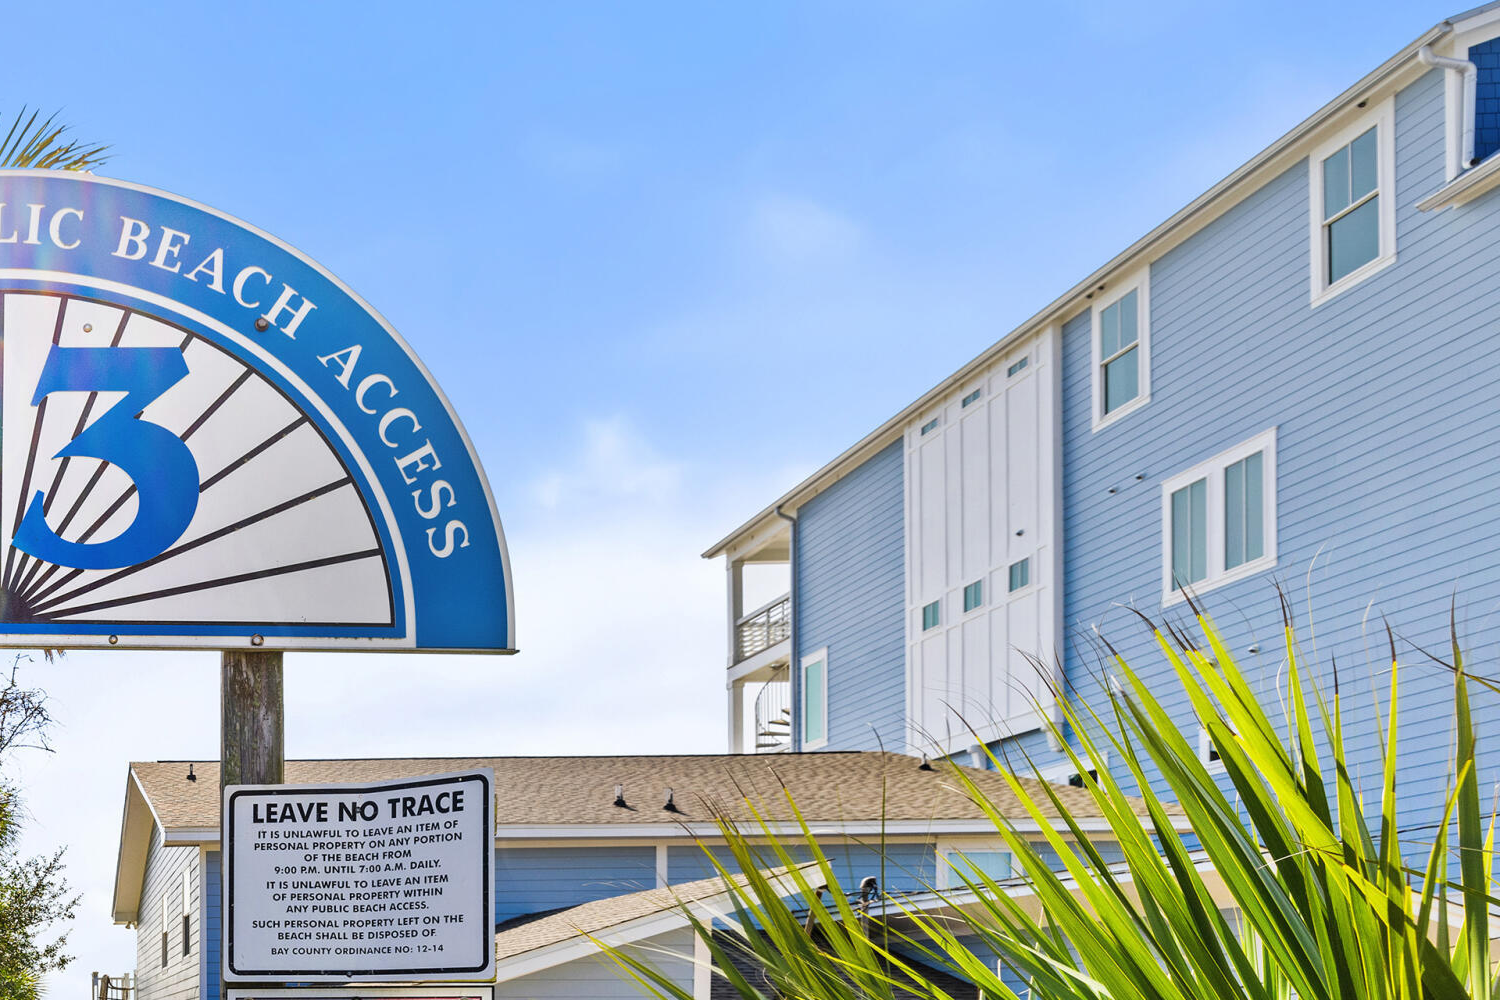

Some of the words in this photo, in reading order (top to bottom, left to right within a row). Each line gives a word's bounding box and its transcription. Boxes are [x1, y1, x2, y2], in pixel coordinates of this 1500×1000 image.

[111, 216, 318, 340] BEACH
[316, 344, 471, 559] ACCESS
[252, 802, 328, 823] LEAVE
[338, 800, 378, 822] NO
[387, 790, 464, 818] TRACE
[258, 830, 267, 839] IT
[270, 830, 279, 838] IS
[283, 829, 342, 838] UNLAWFUL
[345, 829, 359, 837] TO
[362, 826, 393, 837] LEAVE
[396, 824, 412, 834] AN
[416, 822, 440, 832] ITEM
[443, 819, 458, 829] OF
[254, 842, 309, 850] PERSONAL
[312, 841, 365, 850] PROPERTY
[368, 839, 385, 848] ON
[388, 836, 410, 846] ANY
[413, 831, 462, 844] PORTION
[304, 853, 318, 862] OF
[321, 853, 341, 861] THE
[345, 852, 378, 861] BEACH
[382, 849, 411, 859] FROM
[274, 866, 296, 874] 9:00
[300, 865, 320, 874] P.M.
[324, 865, 355, 874] UNTIL
[358, 864, 381, 872] 7:00
[383, 862, 406, 871] A.M.
[410, 859, 441, 869] DAILY.
[266, 881, 275, 889] IT
[279, 880, 288, 889] IS
[292, 880, 350, 889] UNLAWFUL
[353, 880, 367, 888] TO
[371, 877, 401, 887] LEAVE
[404, 876, 420, 885] AN
[424, 874, 448, 884] ITEM
[272, 893, 286, 901] OF
[290, 892, 345, 901] PERSONAL
[349, 890, 400, 900] PROPERTY
[403, 887, 442, 897] WITHIN
[312, 904, 349, 913] PUBLIC
[352, 903, 386, 912] BEACH
[389, 900, 429, 911] ACCESS.
[252, 920, 280, 928] SUCH
[284, 919, 339, 928] PERSONAL
[343, 918, 394, 927] PROPERTY
[397, 916, 419, 925] LEFT
[422, 915, 439, 924] ON
[443, 914, 463, 923] THE
[277, 931, 311, 940] BEACH
[315, 931, 348, 940] SHALL
[352, 931, 364, 940] BE
[368, 929, 418, 939] DISPOSED
[271, 947, 289, 955] BAY
[334, 946, 391, 955] ORDINANCE
[417, 944, 443, 952] 12-14
